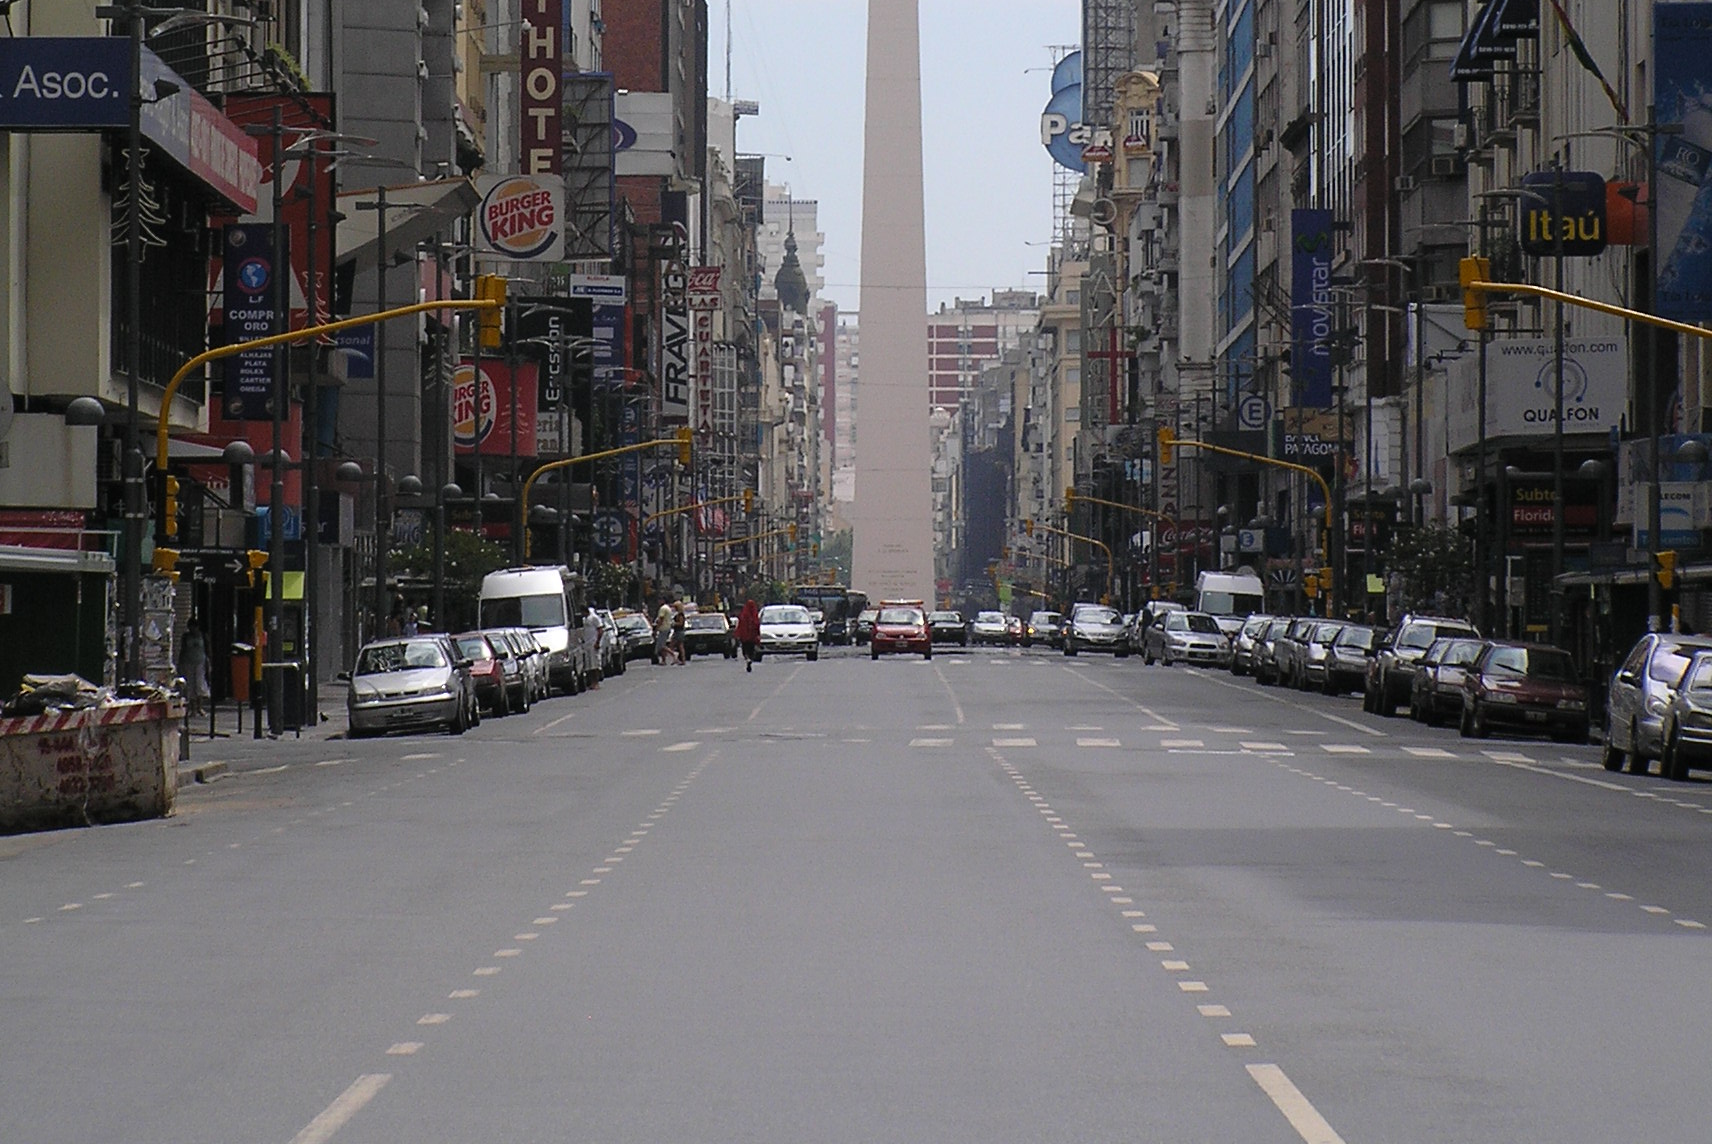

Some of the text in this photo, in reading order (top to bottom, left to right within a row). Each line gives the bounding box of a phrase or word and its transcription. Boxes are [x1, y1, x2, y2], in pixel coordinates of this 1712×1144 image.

[13, 64, 119, 99] Asoc.
[526, 26, 557, 175] HOTE
[488, 190, 551, 221] BURGER
[491, 205, 554, 242] KING
[1529, 208, 1600, 241] Itaú
[229, 310, 284, 320] COMPR
[244, 321, 269, 331] ORO
[545, 316, 560, 402] Ercsson
[1513, 508, 1556, 522] Florid
